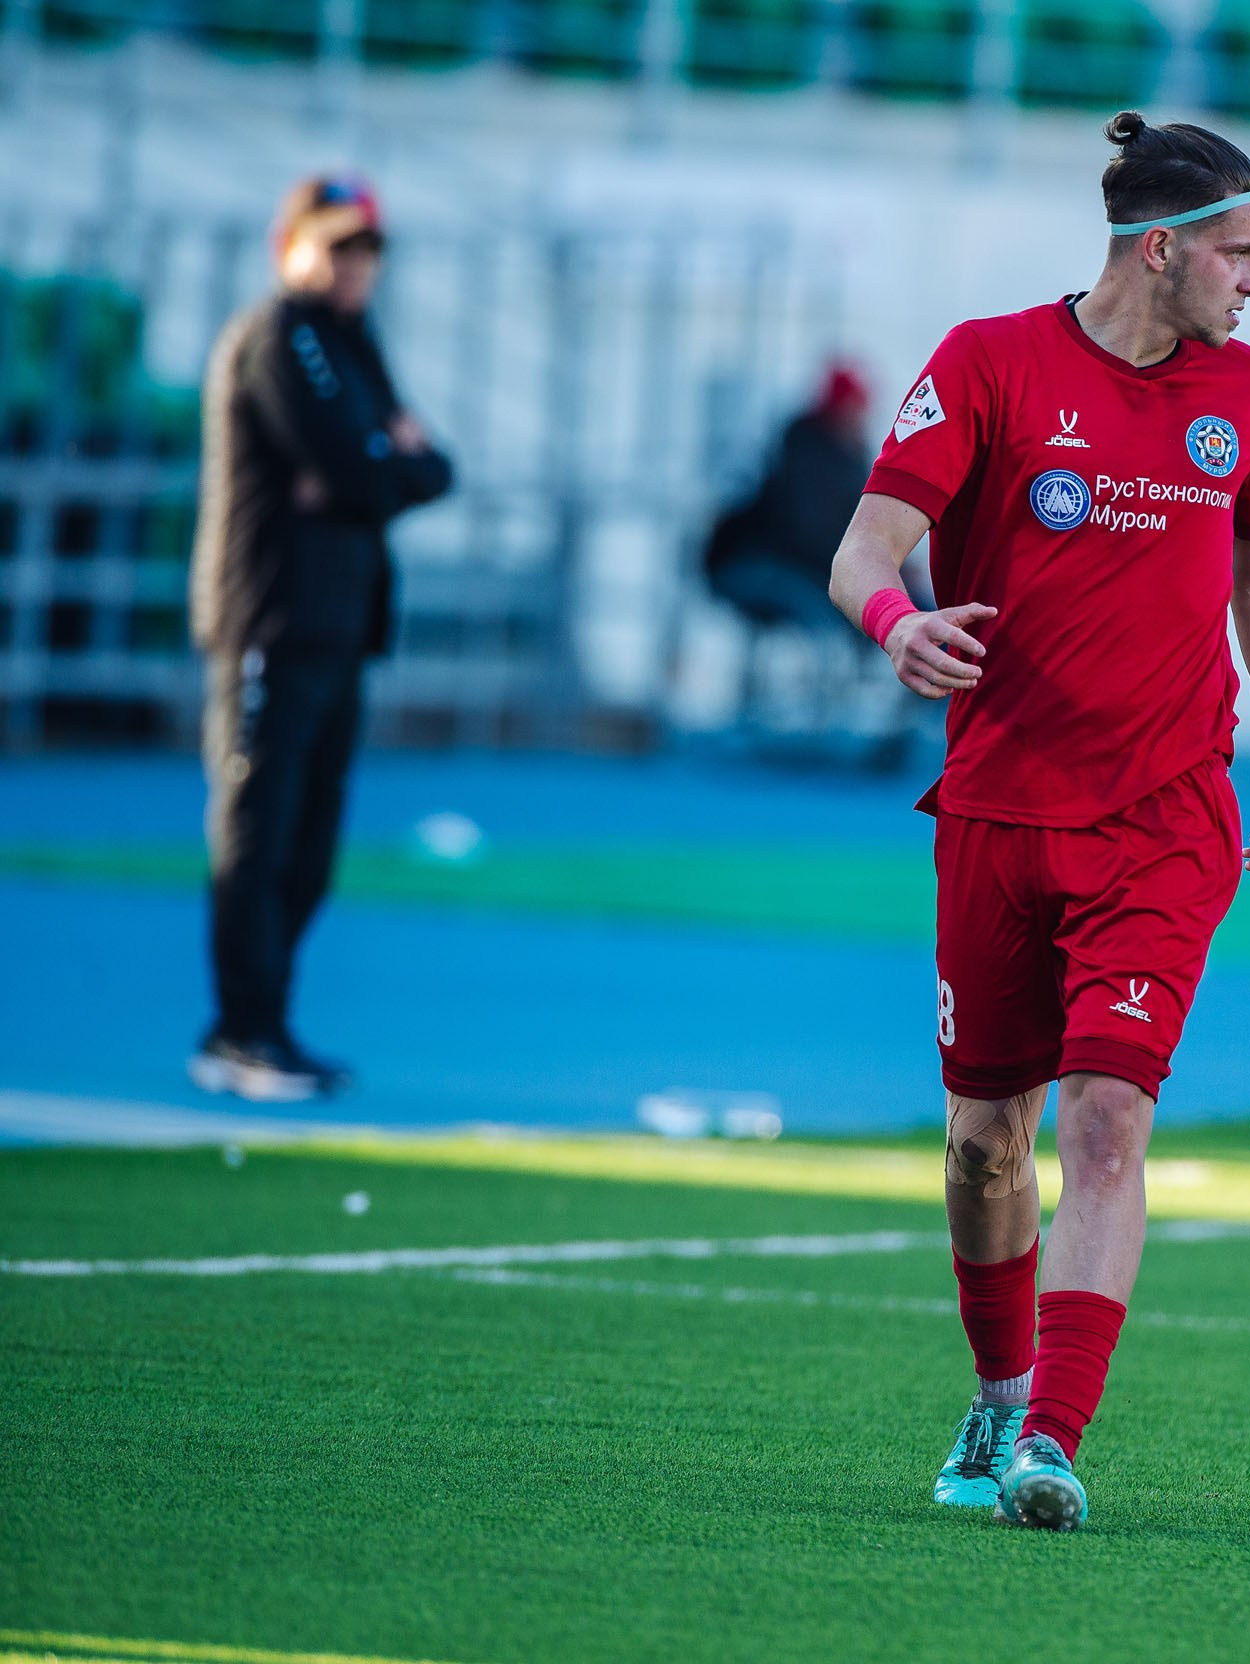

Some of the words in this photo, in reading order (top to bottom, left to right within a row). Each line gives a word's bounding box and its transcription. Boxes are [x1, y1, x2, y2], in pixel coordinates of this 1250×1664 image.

[1045, 434, 1091, 448] JÖGEL
[1202, 463, 1228, 475] МУРОМ
[1095, 474, 1233, 510] РусТехнологии
[1090, 504, 1167, 532] Муром
[1109, 1001, 1152, 1022] JÖGEL
